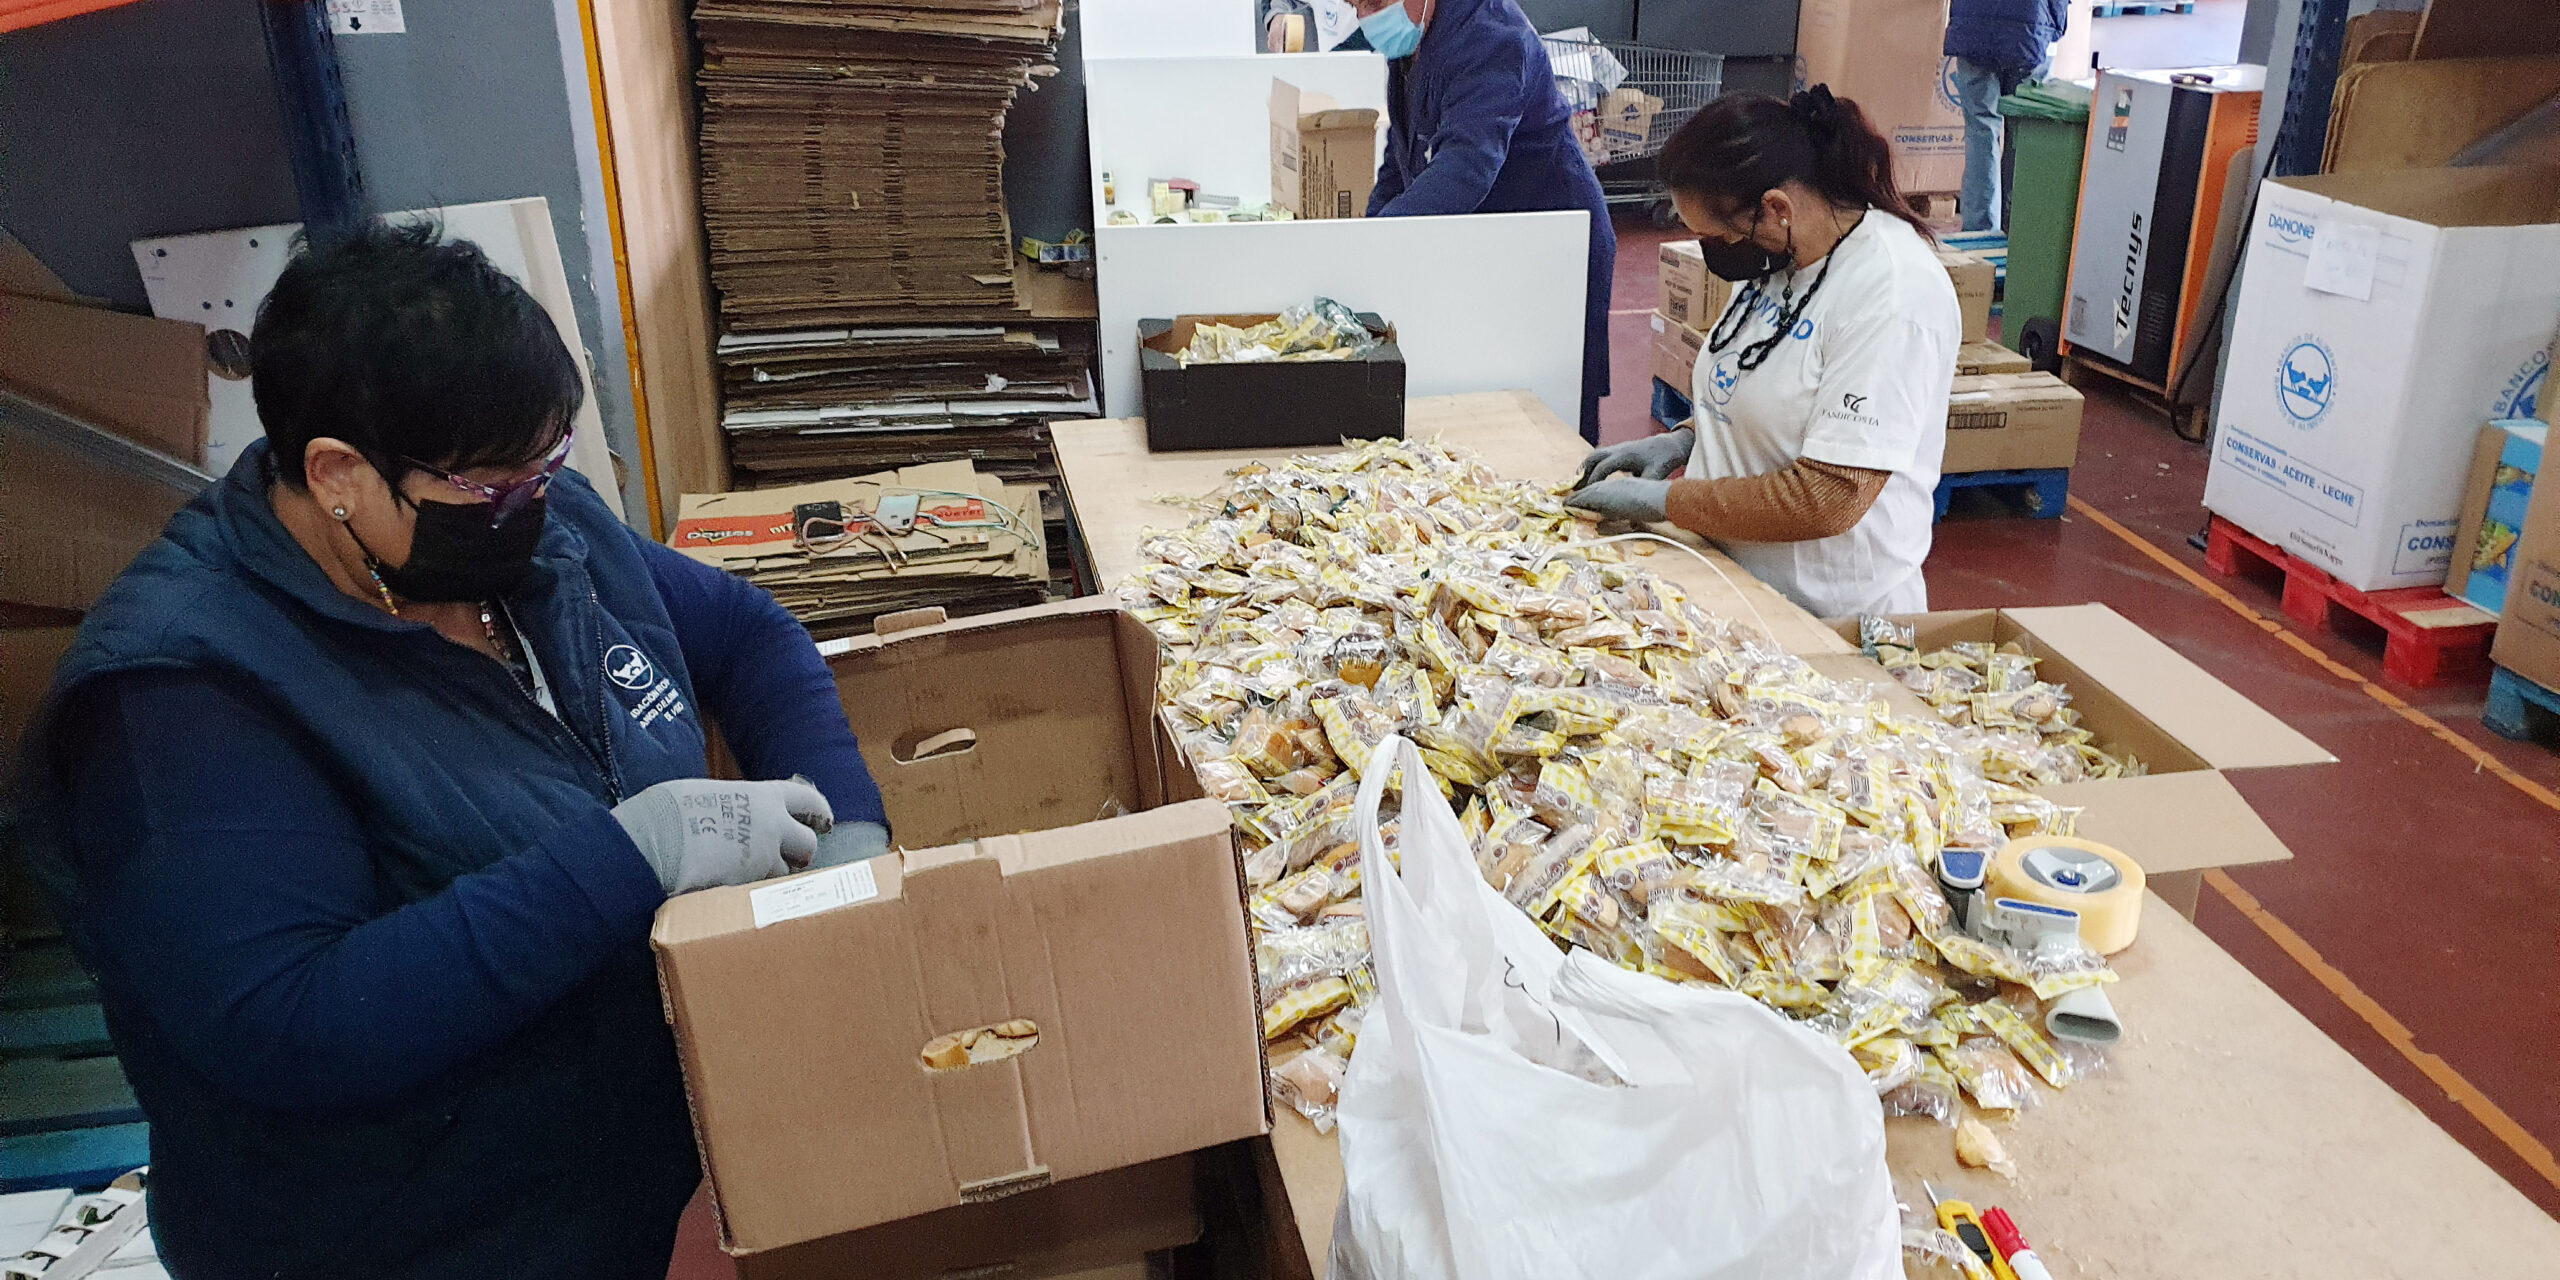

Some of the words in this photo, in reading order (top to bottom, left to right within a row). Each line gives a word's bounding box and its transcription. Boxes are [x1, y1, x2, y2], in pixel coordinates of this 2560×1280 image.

[1895, 134, 1954, 144] CONSERVAS
[2115, 210, 2144, 330] Tecnys
[2226, 437, 2277, 469] CONSERVAS
[2283, 464, 2316, 487] ACEITE
[2323, 483, 2355, 507] LECHE
[700, 816, 717, 835] CE
